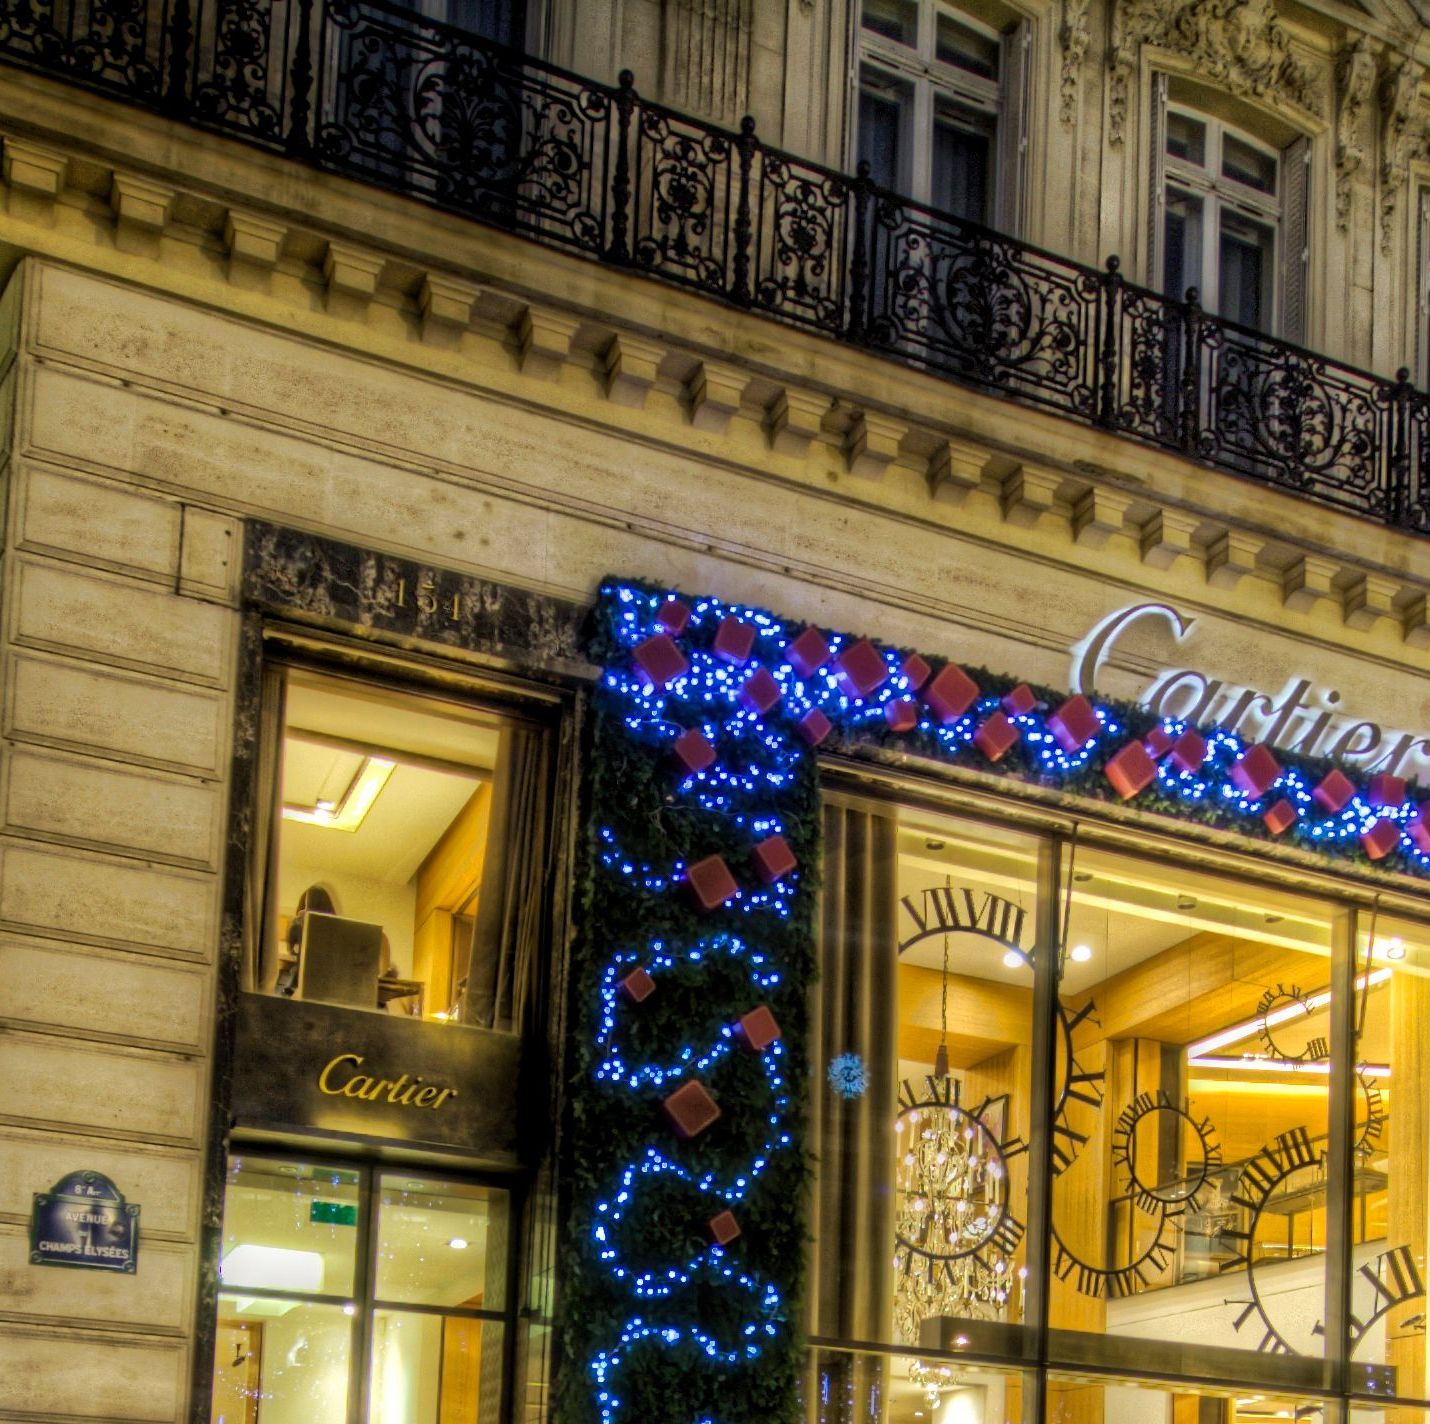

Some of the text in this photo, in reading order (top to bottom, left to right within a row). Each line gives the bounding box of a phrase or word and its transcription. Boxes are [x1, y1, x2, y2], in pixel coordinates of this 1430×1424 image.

[397, 578, 459, 621] 151
[319, 1053, 458, 1110] Cartier
[65, 1211, 108, 1225] AVENUE
[39, 1241, 82, 1255] CHAMPS
